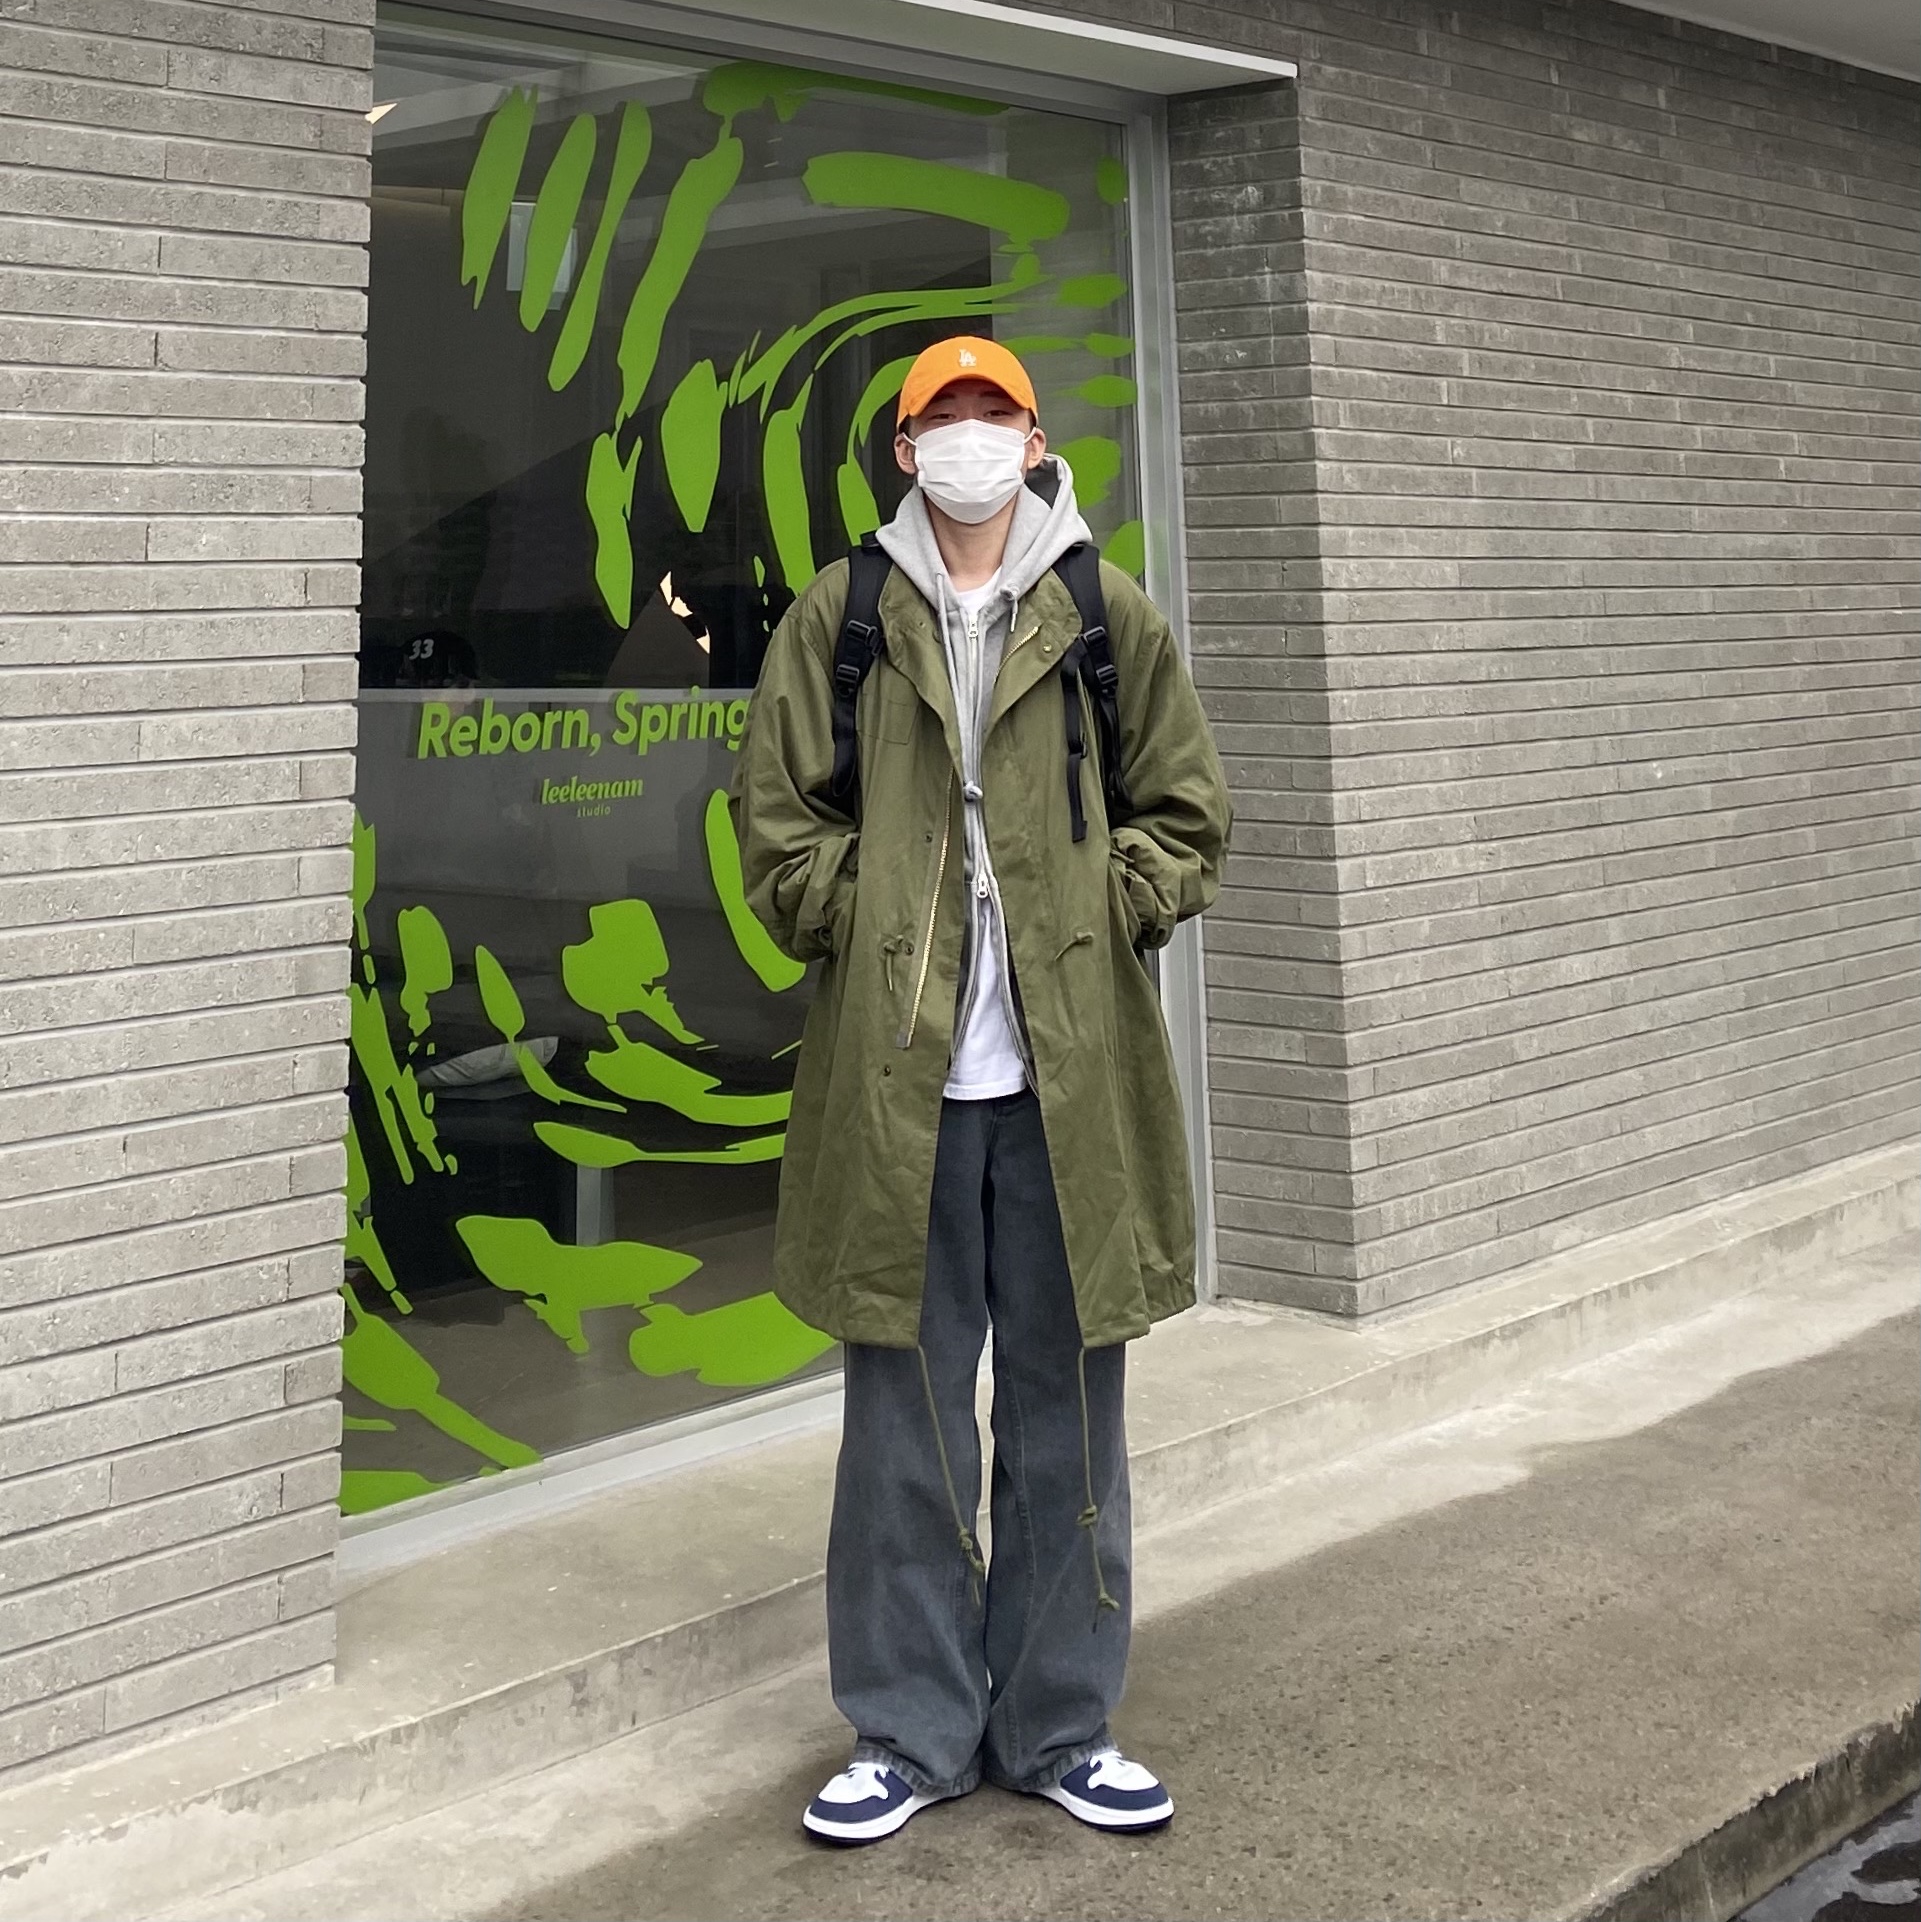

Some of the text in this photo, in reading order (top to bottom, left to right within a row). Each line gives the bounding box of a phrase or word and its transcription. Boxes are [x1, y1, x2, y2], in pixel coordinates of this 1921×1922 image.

[959, 348, 977, 367] LA
[408, 638, 435, 660] 33
[417, 685, 750, 760] Reborn, Spring
[541, 775, 644, 805] leeleenam
[577, 803, 611, 818] studio
